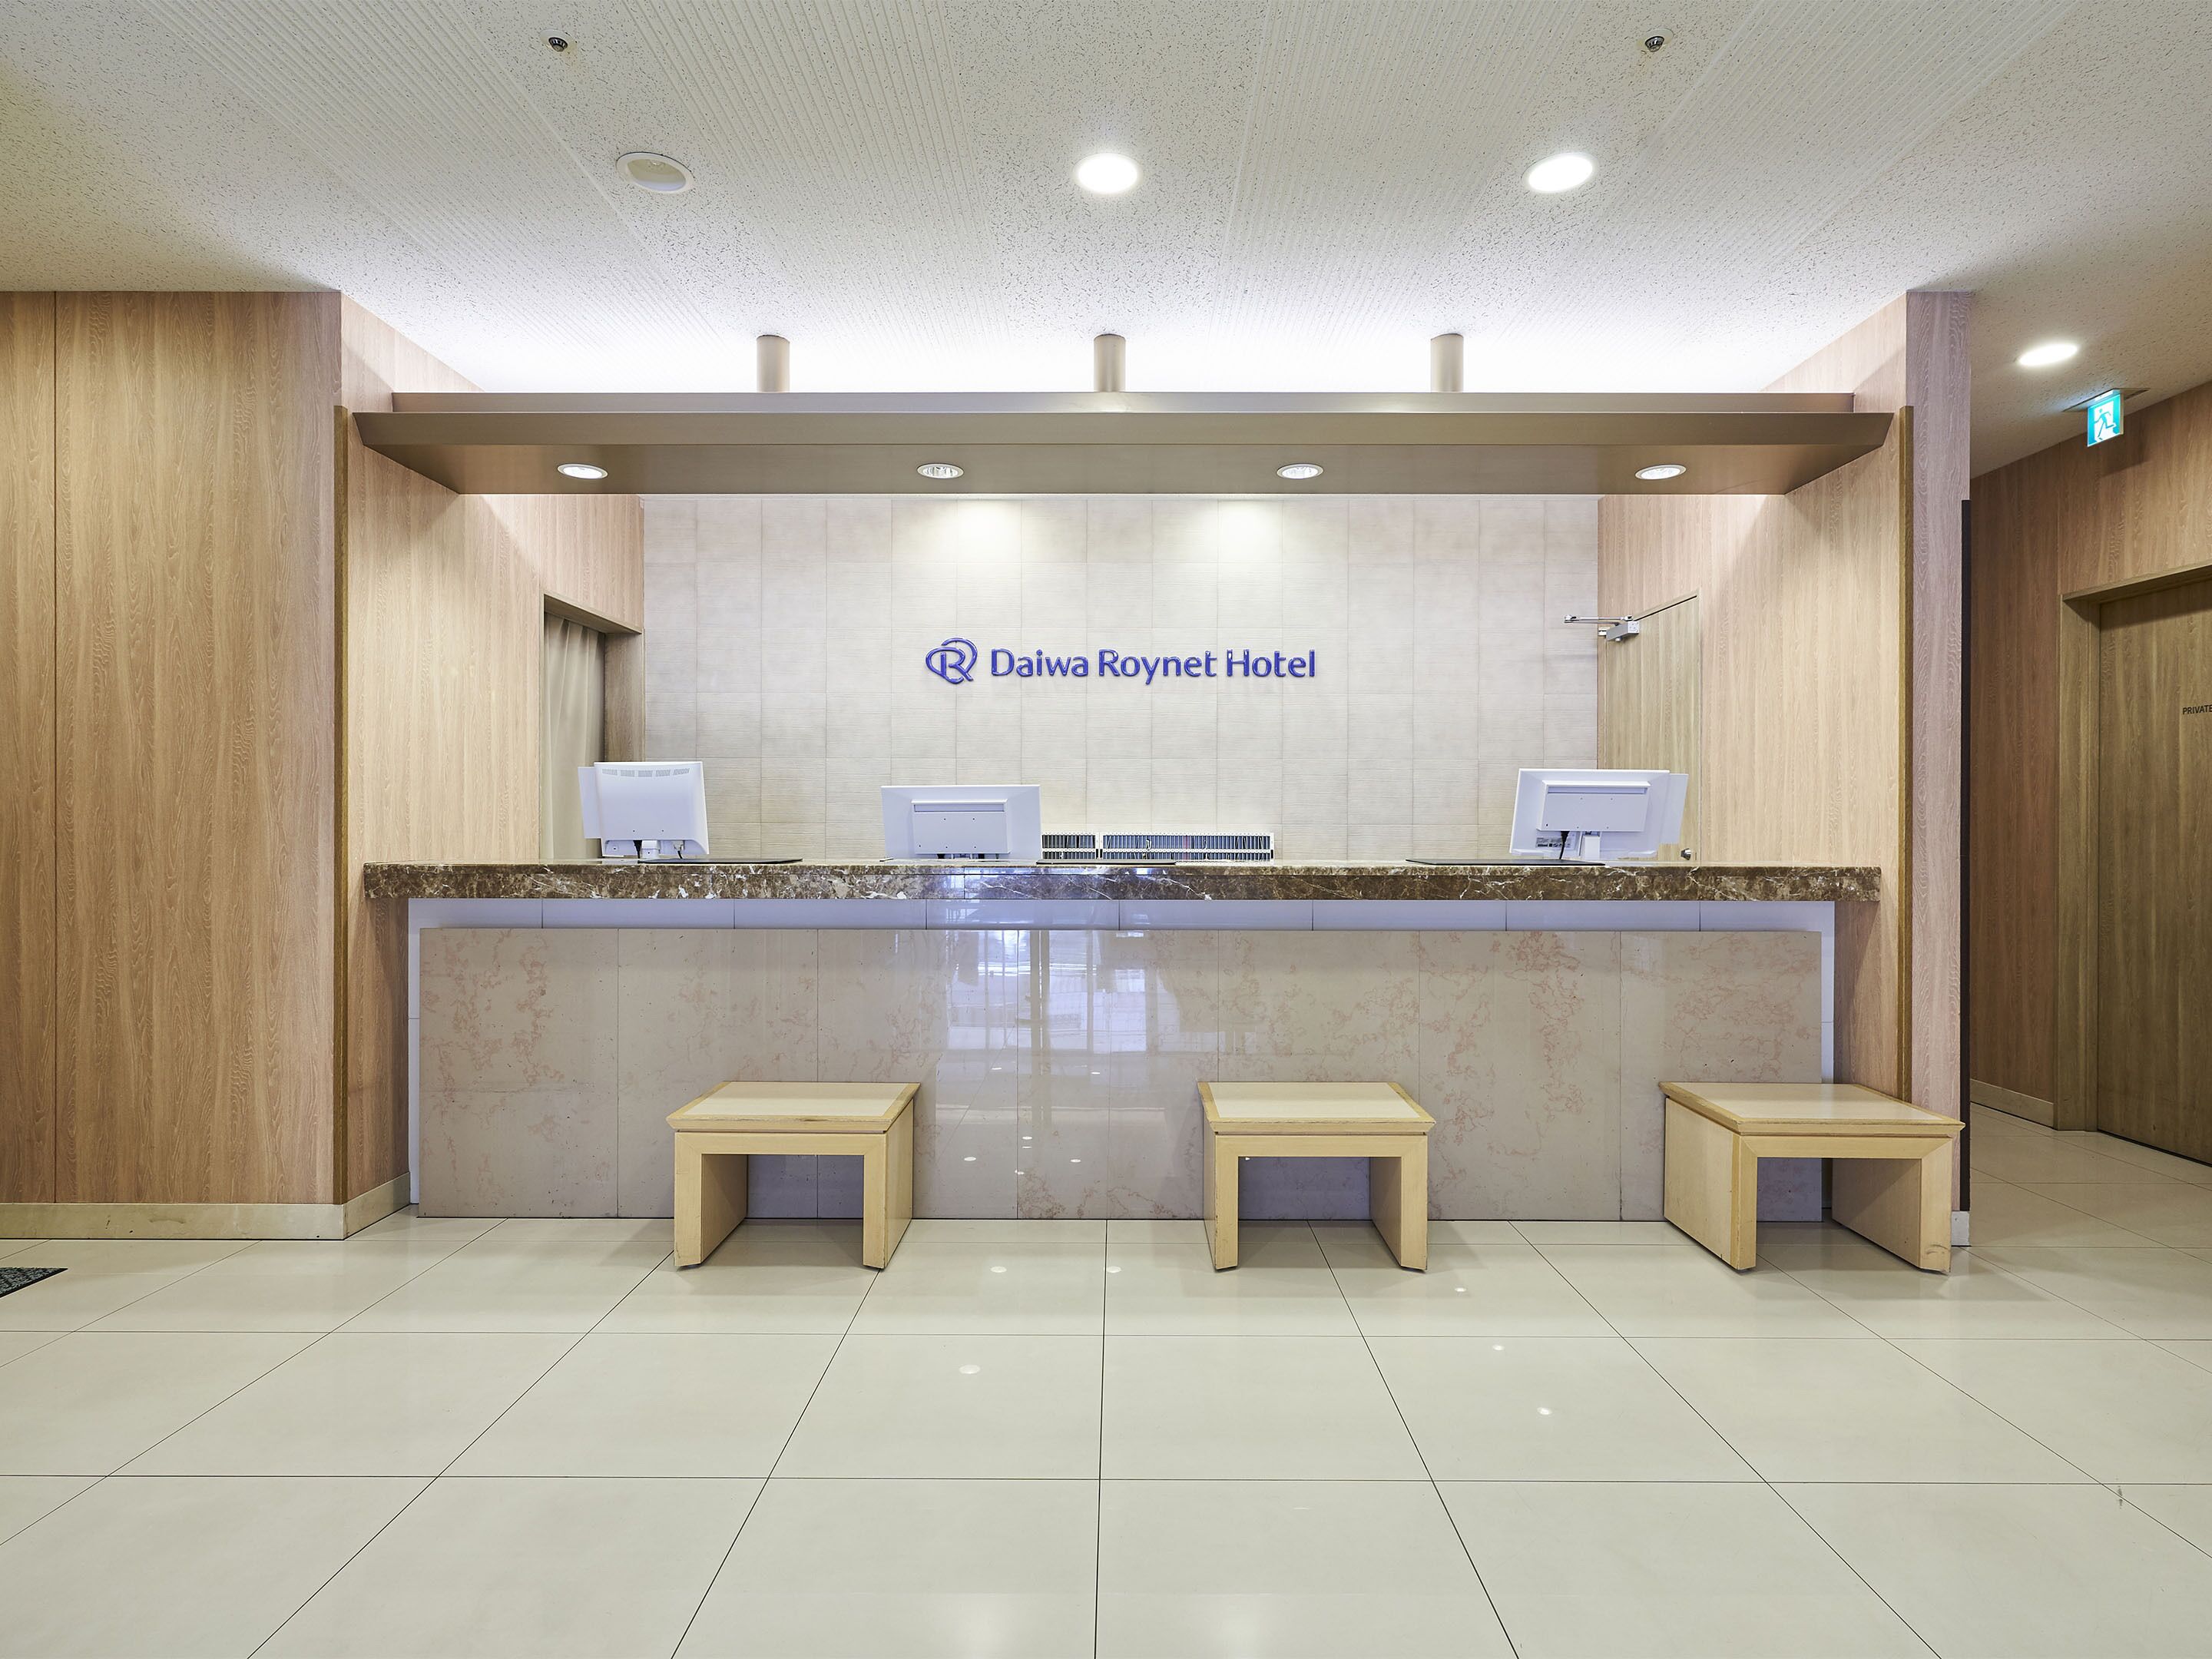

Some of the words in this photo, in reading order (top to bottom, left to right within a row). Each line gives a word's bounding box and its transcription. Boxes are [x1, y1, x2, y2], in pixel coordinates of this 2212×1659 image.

[991, 649, 1089, 677] Daiwa
[1098, 649, 1217, 685] Roynet
[1227, 649, 1316, 677] Hotel
[2182, 704, 2212, 715] PRIVATE
